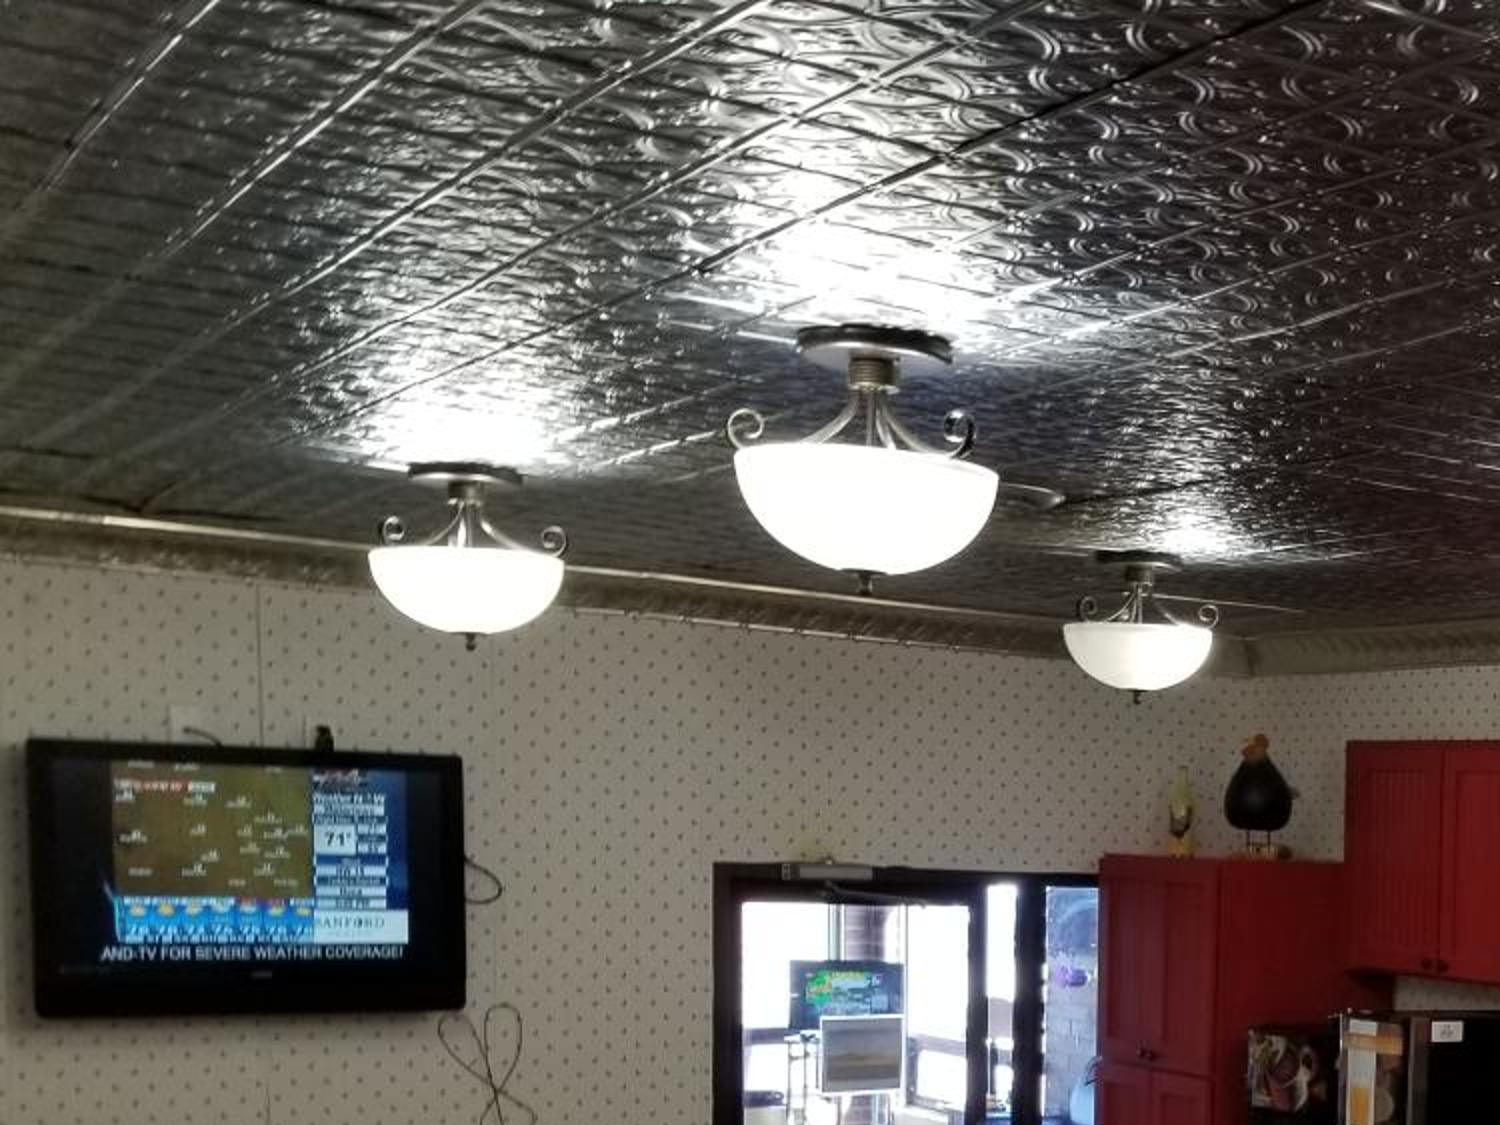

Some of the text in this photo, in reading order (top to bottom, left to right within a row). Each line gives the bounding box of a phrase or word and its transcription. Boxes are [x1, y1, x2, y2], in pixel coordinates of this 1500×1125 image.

[161, 946, 191, 961] FOR
[195, 946, 251, 961] SEVERE
[253, 945, 322, 960] WEATHER
